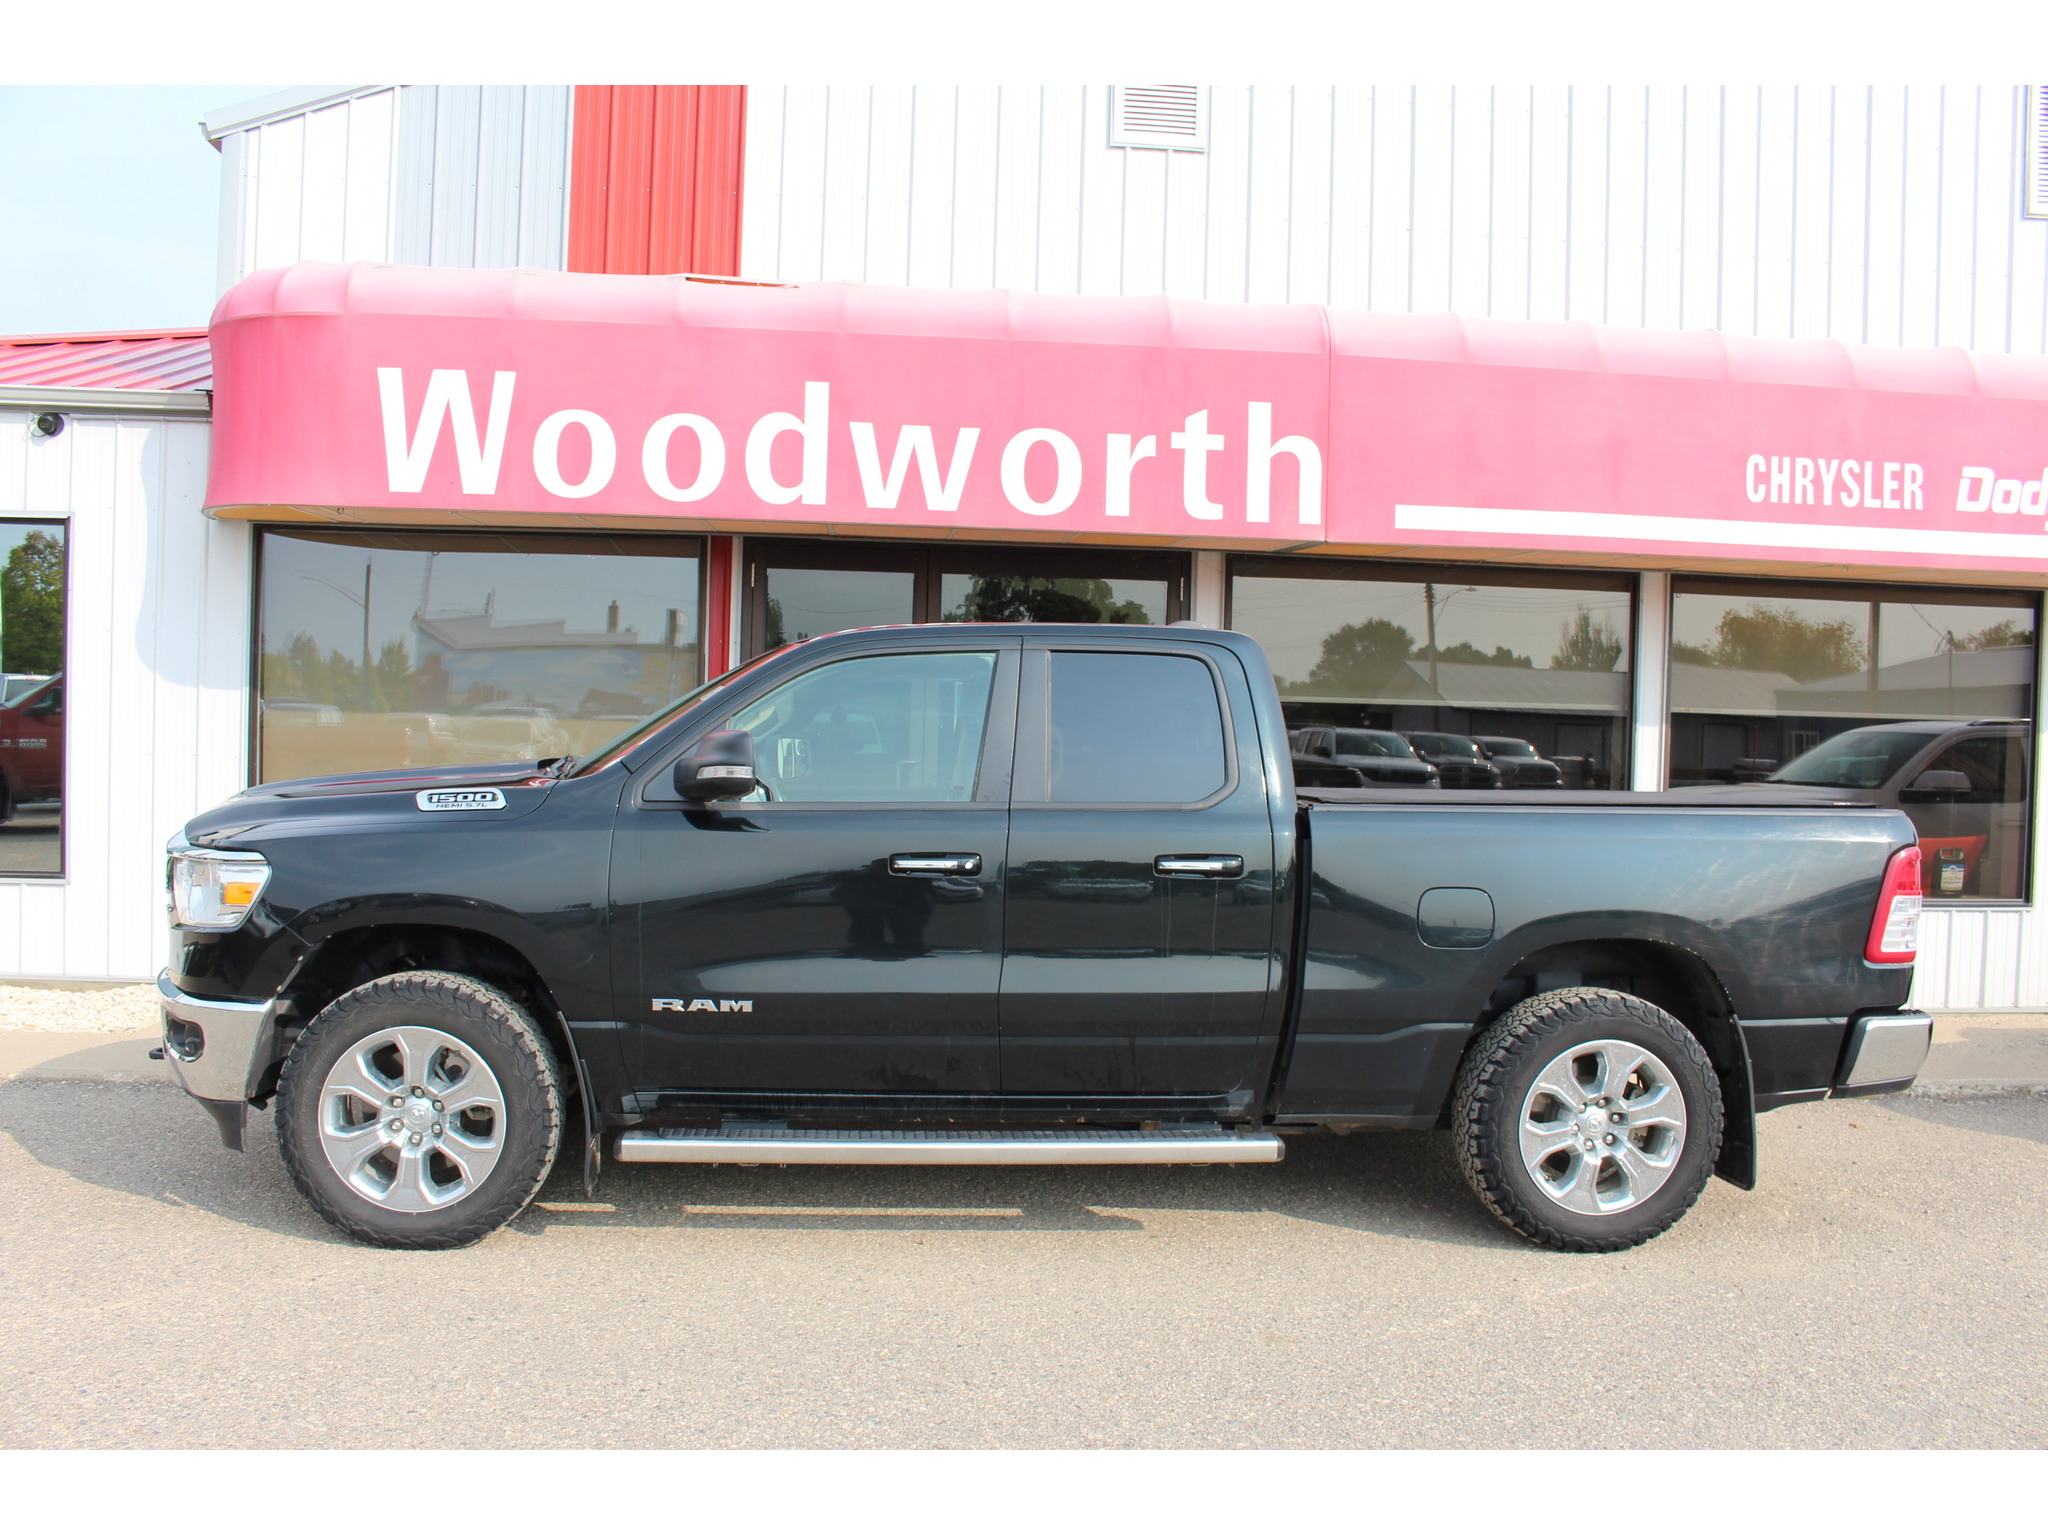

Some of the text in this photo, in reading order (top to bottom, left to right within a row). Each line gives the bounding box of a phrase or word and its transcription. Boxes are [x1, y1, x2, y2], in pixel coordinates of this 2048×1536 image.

[377, 367, 1323, 525] Woodworth
[1745, 453, 2048, 531] CHRYSLER Dod
[428, 792, 494, 803] 1500
[651, 998, 753, 1013] RAM
